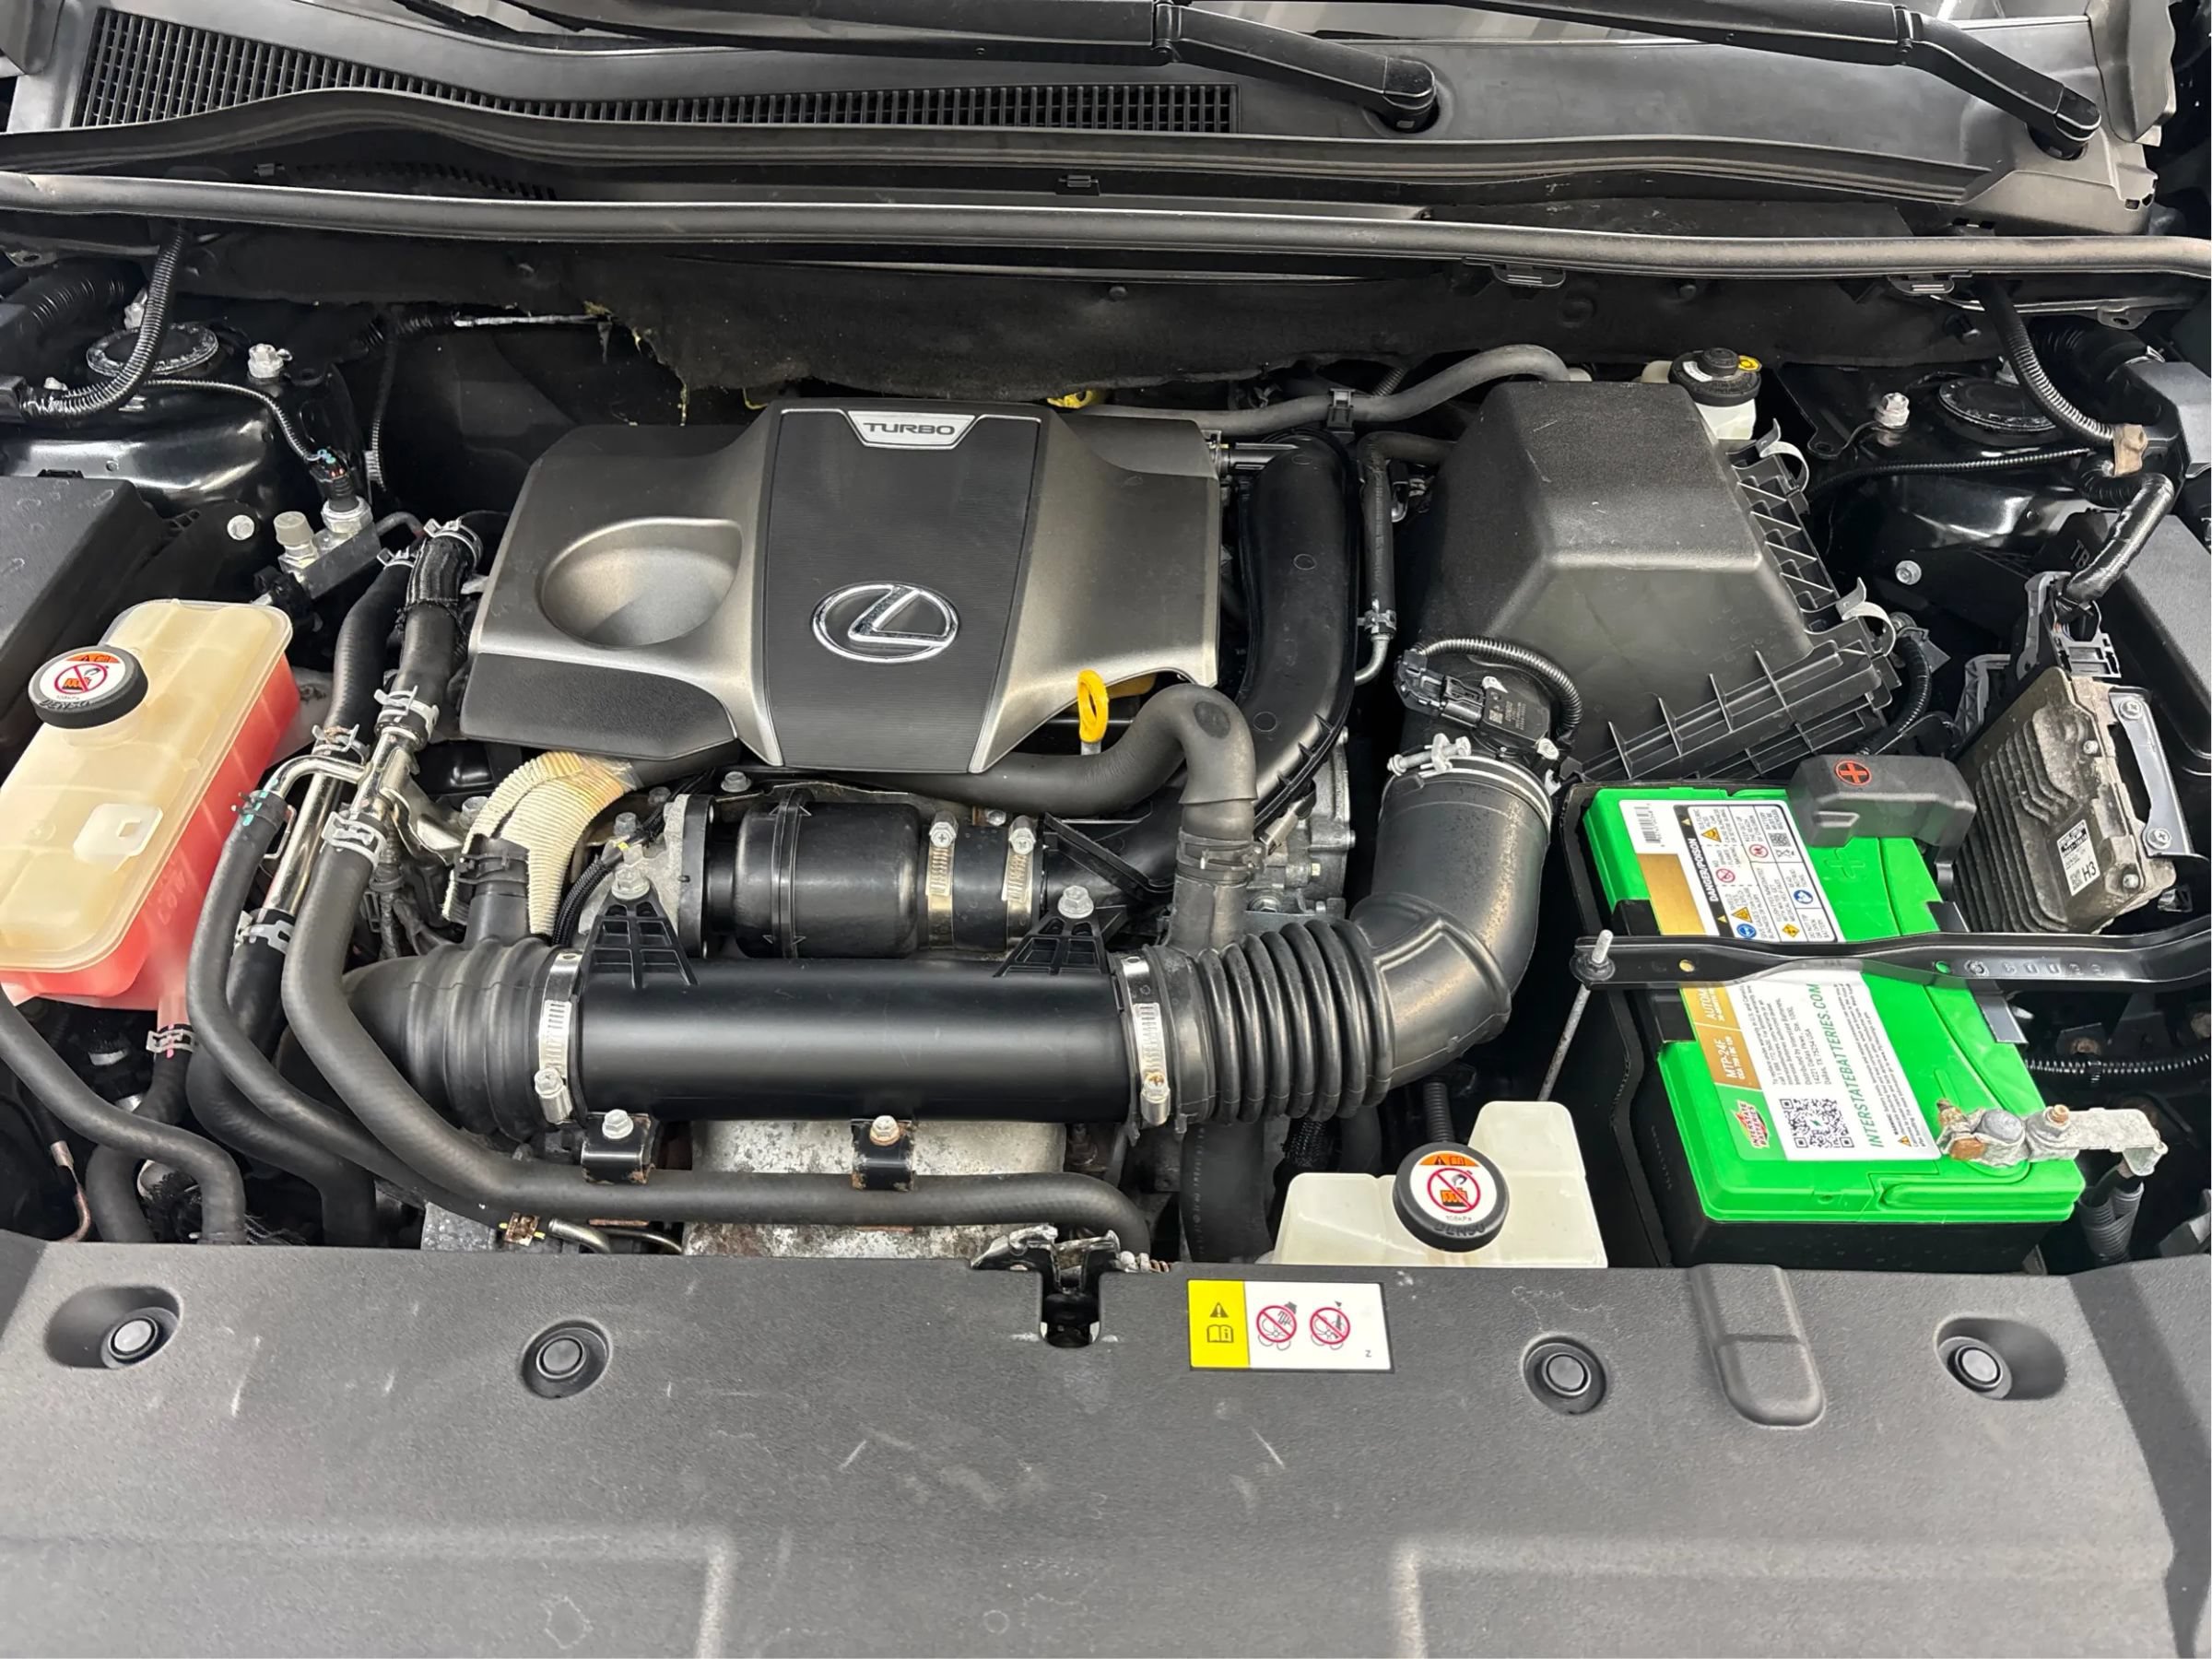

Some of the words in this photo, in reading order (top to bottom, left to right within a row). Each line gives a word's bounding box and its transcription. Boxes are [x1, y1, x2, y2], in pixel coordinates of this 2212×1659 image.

[863, 422, 956, 436] TURBO
[39, 698, 91, 711] DENSO
[1687, 838, 1719, 901] DANGER/POISON
[2081, 861, 2097, 882] H3
[1713, 1038, 1737, 1077] MTP-24F
[1805, 983, 1883, 1147] INTERSTATEBATTERIES.COM
[1739, 1102, 1760, 1146] INTERSTATE
[1747, 1105, 1767, 1145] BATTERIES
[1433, 1222, 1486, 1237] DENSO
